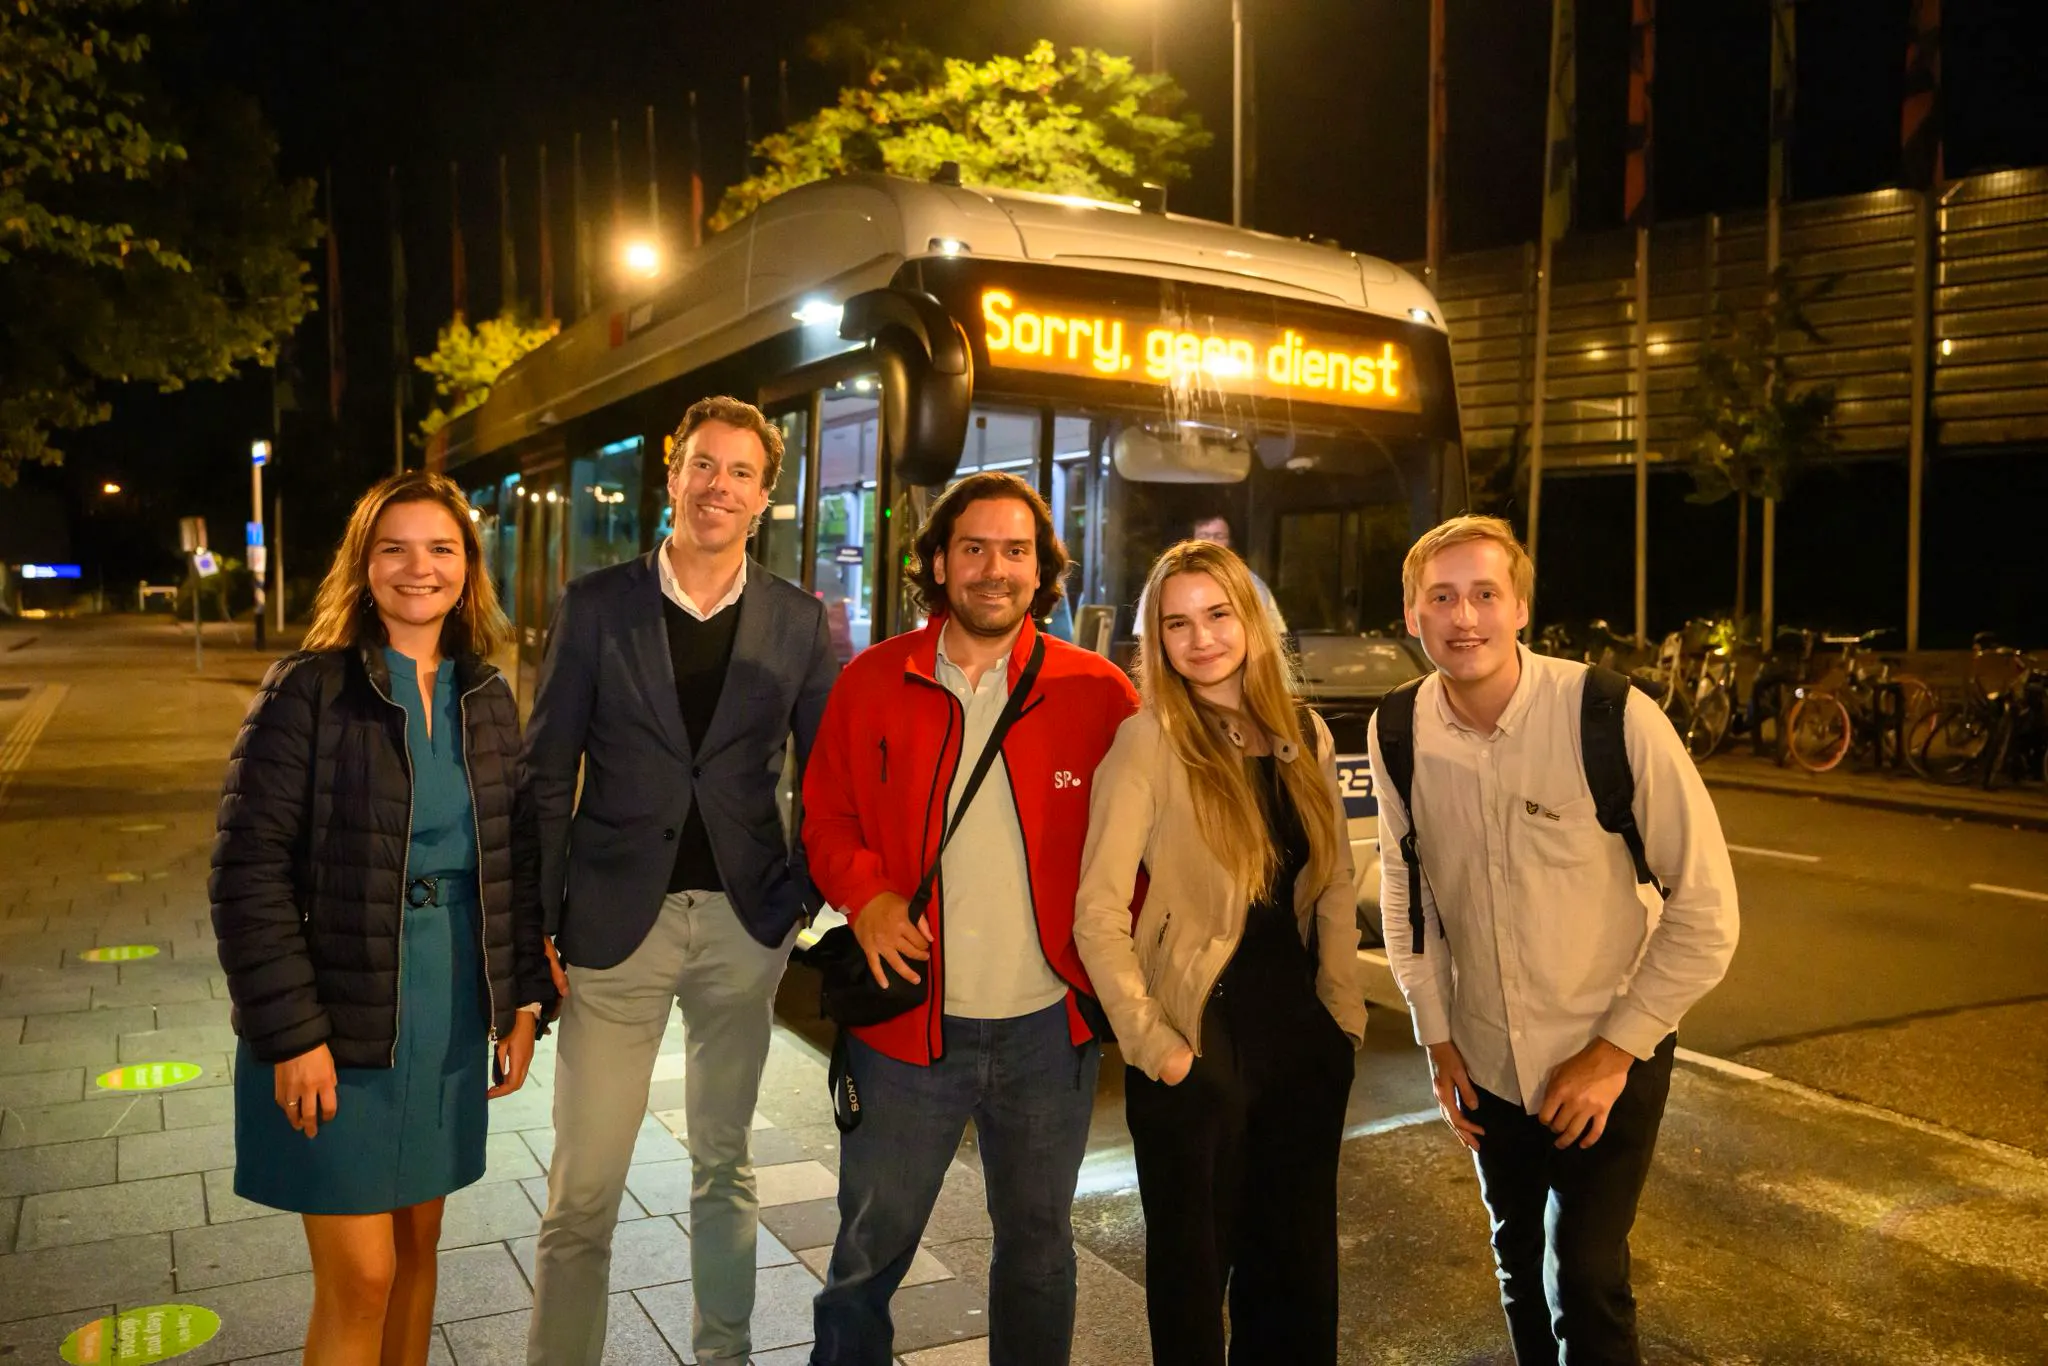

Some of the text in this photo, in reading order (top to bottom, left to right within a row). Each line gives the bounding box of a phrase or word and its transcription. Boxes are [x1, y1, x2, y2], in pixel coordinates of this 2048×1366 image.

[981, 290, 1399, 397] Sorry, geen dienst
[1338, 768, 1377, 797] RE
[846, 1074, 860, 1112] SONY
[121, 1317, 142, 1359] distance!
[143, 1311, 166, 1333] Keep
